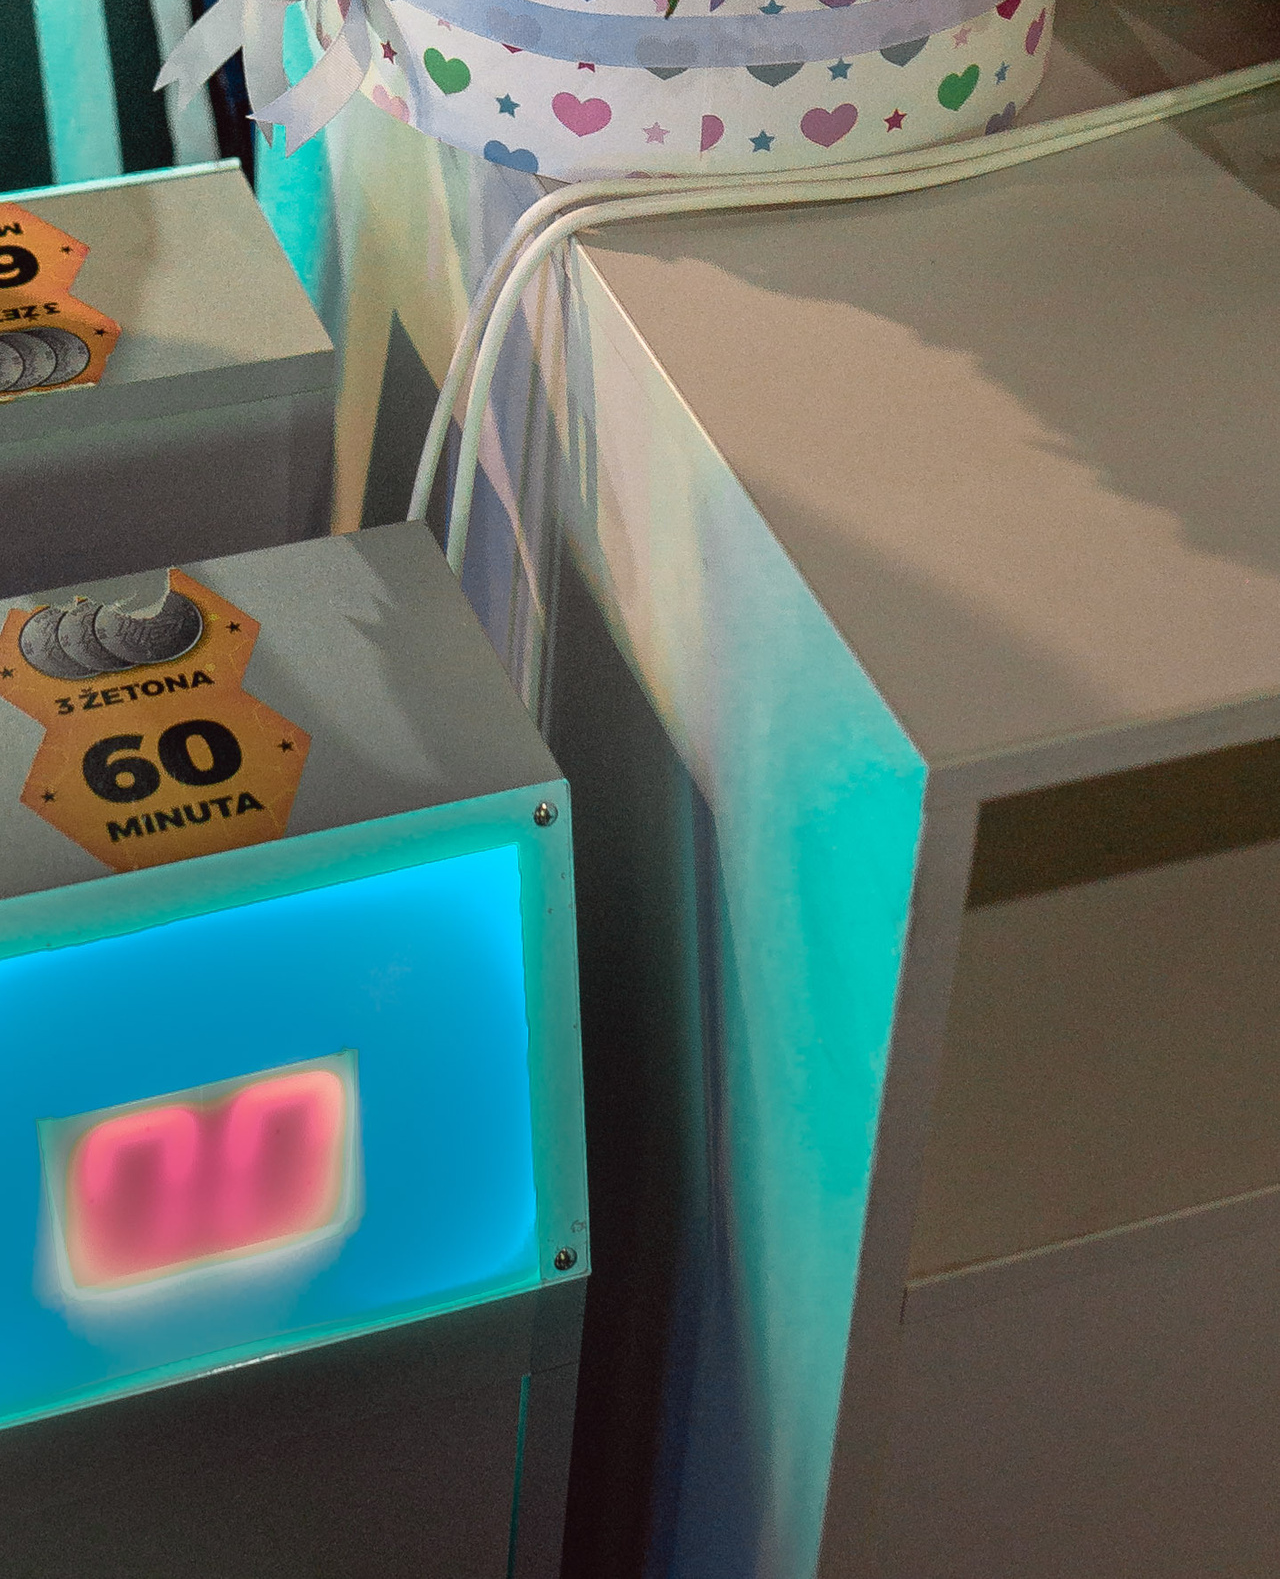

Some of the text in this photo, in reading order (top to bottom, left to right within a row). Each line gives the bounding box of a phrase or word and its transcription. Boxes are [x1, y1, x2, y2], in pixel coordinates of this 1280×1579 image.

[44, 302, 60, 315] 3
[55, 670, 215, 715] 3 ŽETONA
[82, 719, 242, 803] 60
[106, 792, 265, 842] MINUTA
